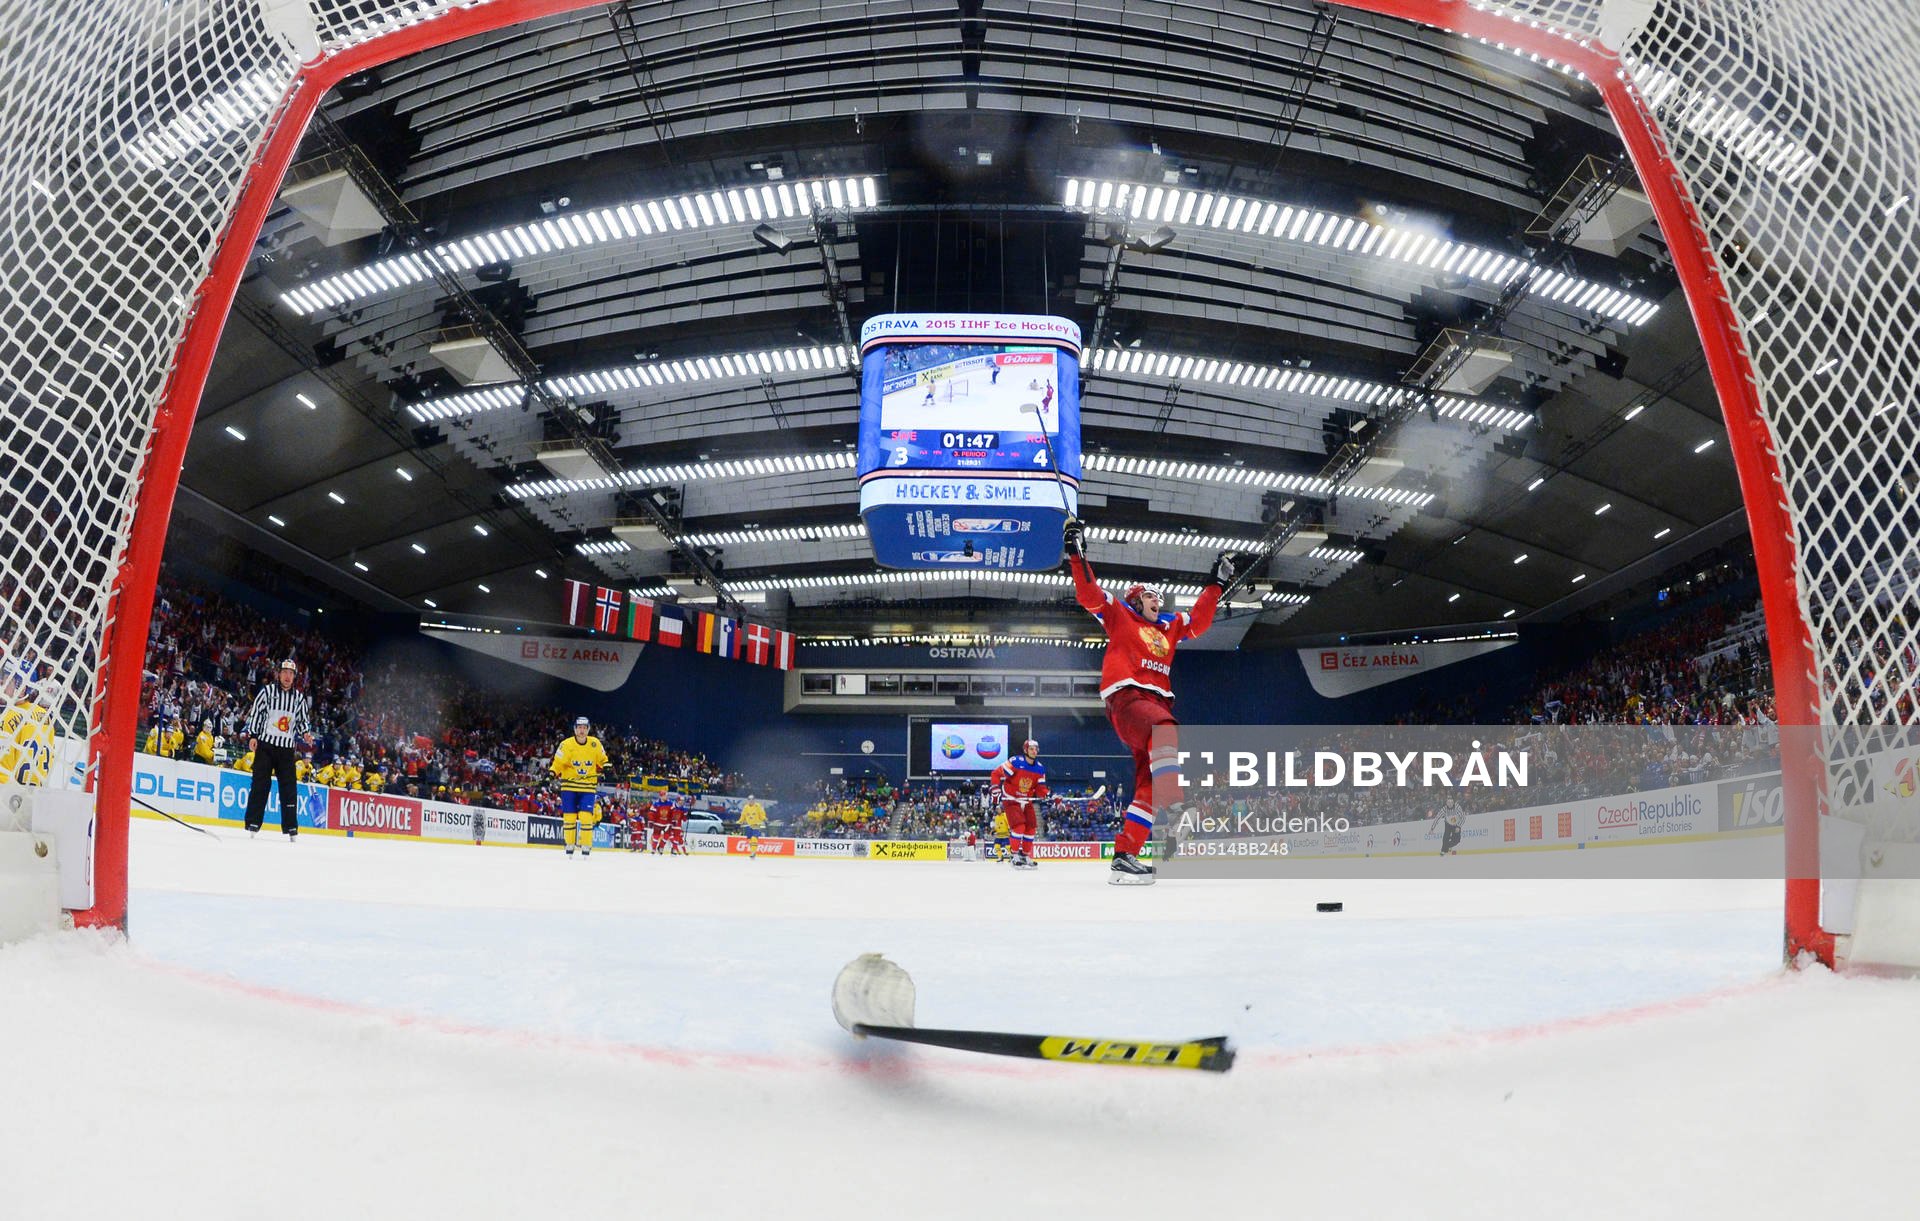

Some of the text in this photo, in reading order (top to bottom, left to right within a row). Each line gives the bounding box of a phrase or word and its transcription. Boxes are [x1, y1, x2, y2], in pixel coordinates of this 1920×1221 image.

[864, 320, 919, 335] OSTRAVA
[926, 320, 956, 329] 2015
[960, 320, 991, 329] IIHF
[995, 320, 1017, 330] Ice
[1021, 321, 1069, 335] Hockey
[891, 431, 917, 441] SWE
[943, 433, 994, 449] 01:47
[894, 446, 909, 465] 3
[1033, 449, 1048, 467] 4
[896, 483, 1031, 500] HOCKEY & SMILE
[542, 645, 620, 662] ČEZ ARÉNA
[929, 647, 996, 659] OSTRAVA
[1343, 651, 1419, 667] ČEZ ARÉNA
[1141, 658, 1171, 676] РОССИ
[340, 797, 412, 831] KRUŠOVICE
[438, 811, 471, 826] TISSOT
[500, 818, 526, 831] TISSOT
[529, 823, 556, 839] NIVEA
[1639, 821, 1693, 834] Land of Stories
[698, 840, 725, 848] ŠKODA
[813, 843, 851, 851] TISSOT
[1033, 843, 1091, 858] KRUŠOVICE
[1060, 1039, 1182, 1065] CCM
